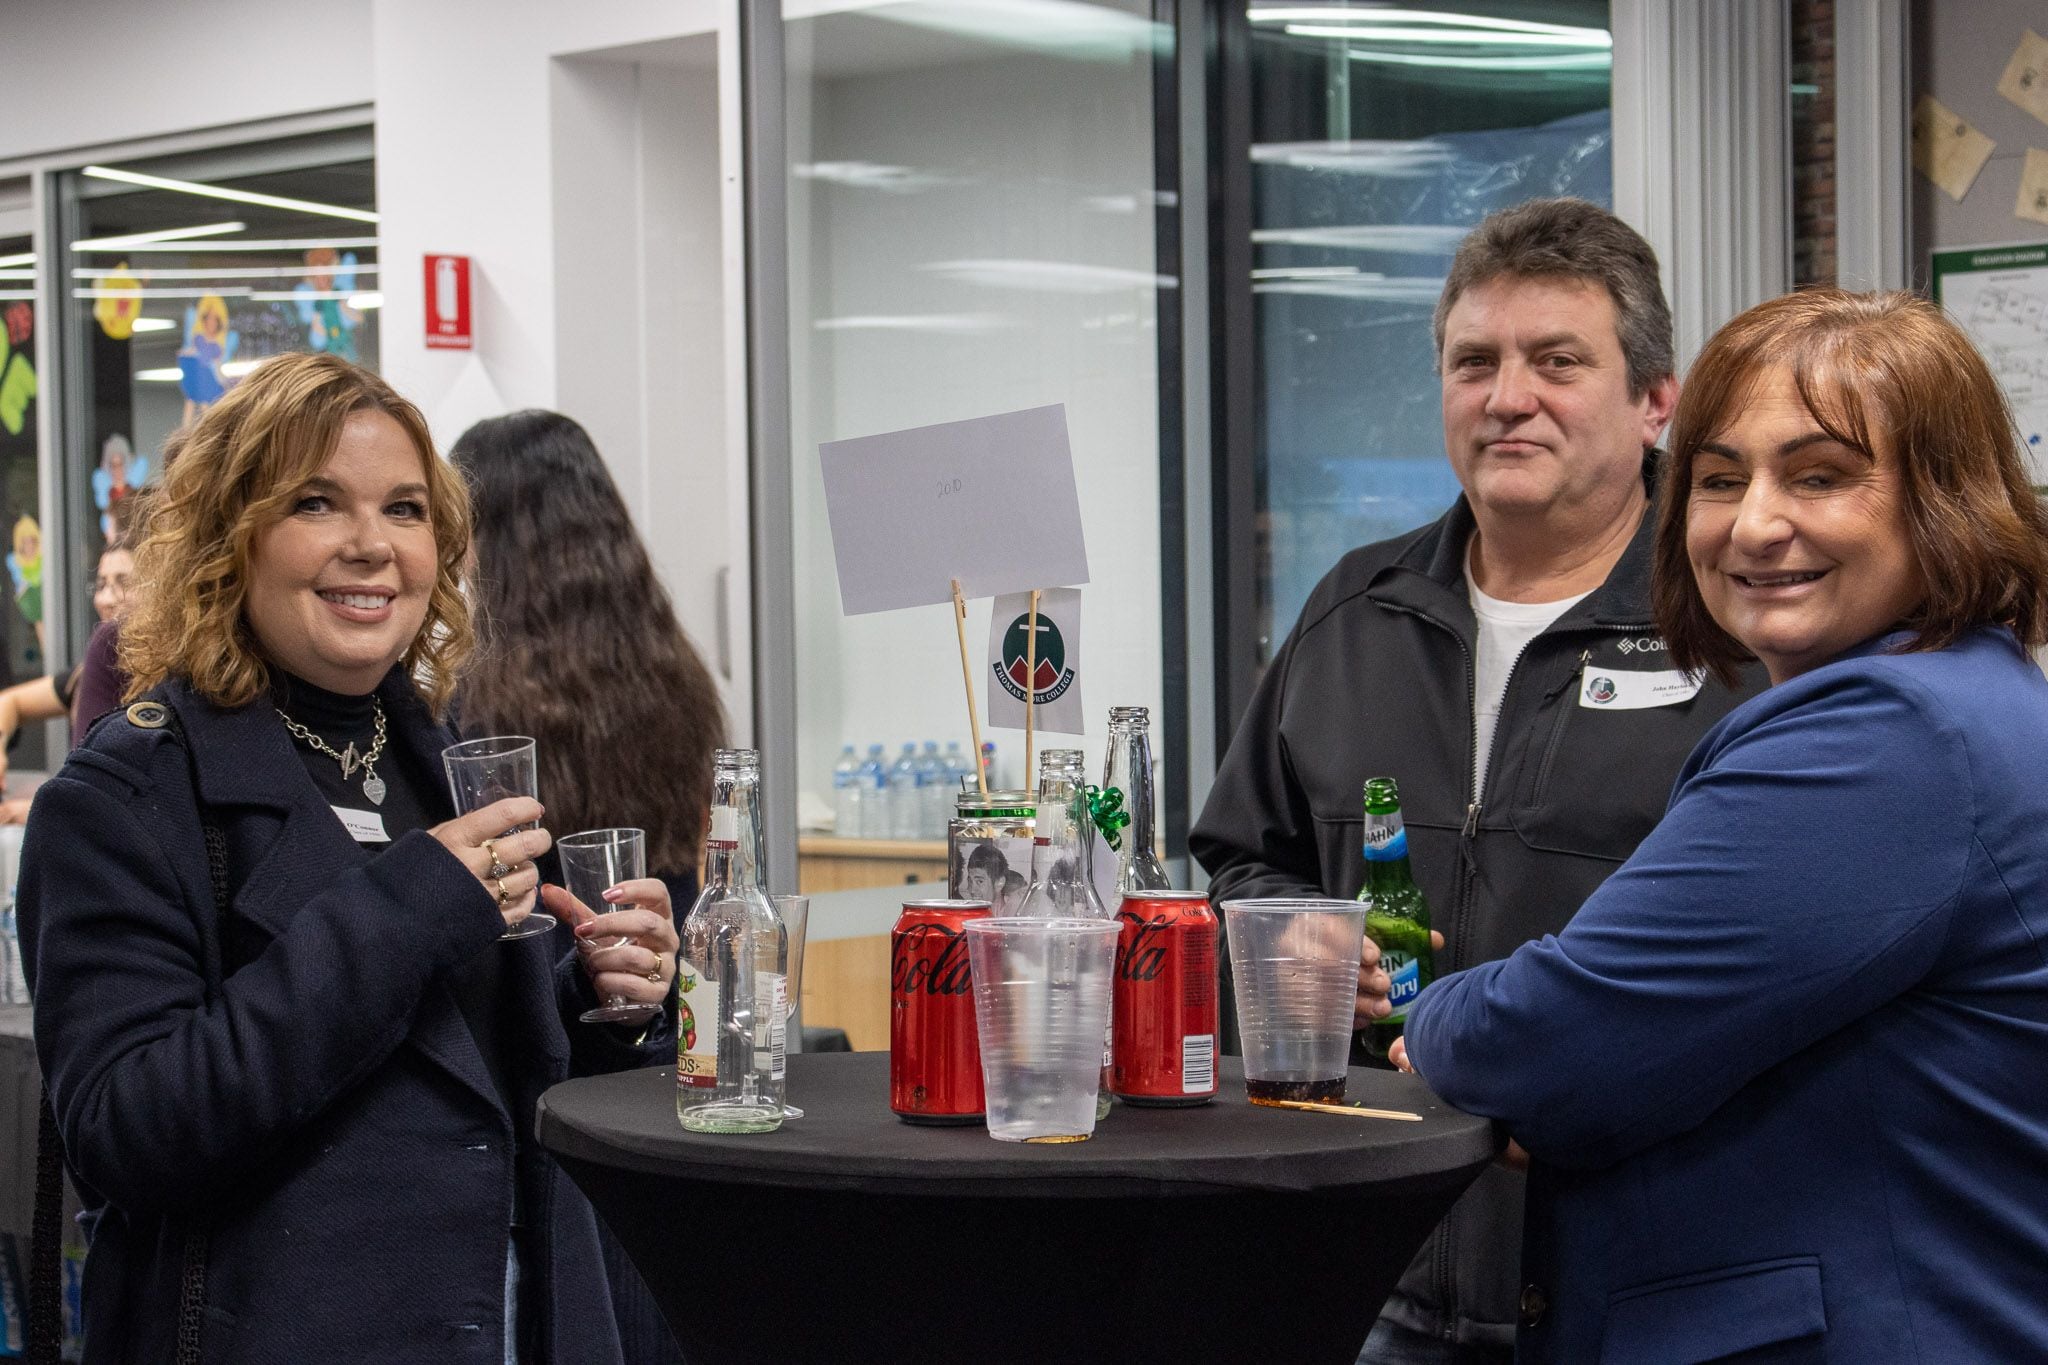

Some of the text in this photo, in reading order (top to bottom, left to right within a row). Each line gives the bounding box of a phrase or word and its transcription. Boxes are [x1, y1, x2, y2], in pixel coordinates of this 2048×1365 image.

[996, 665, 1021, 697] THOMAS
[1046, 671, 1072, 701] COLLEGE
[1365, 825, 1395, 845] HAHN
[1378, 953, 1403, 973] HN
[1391, 978, 1418, 1000] Dry
